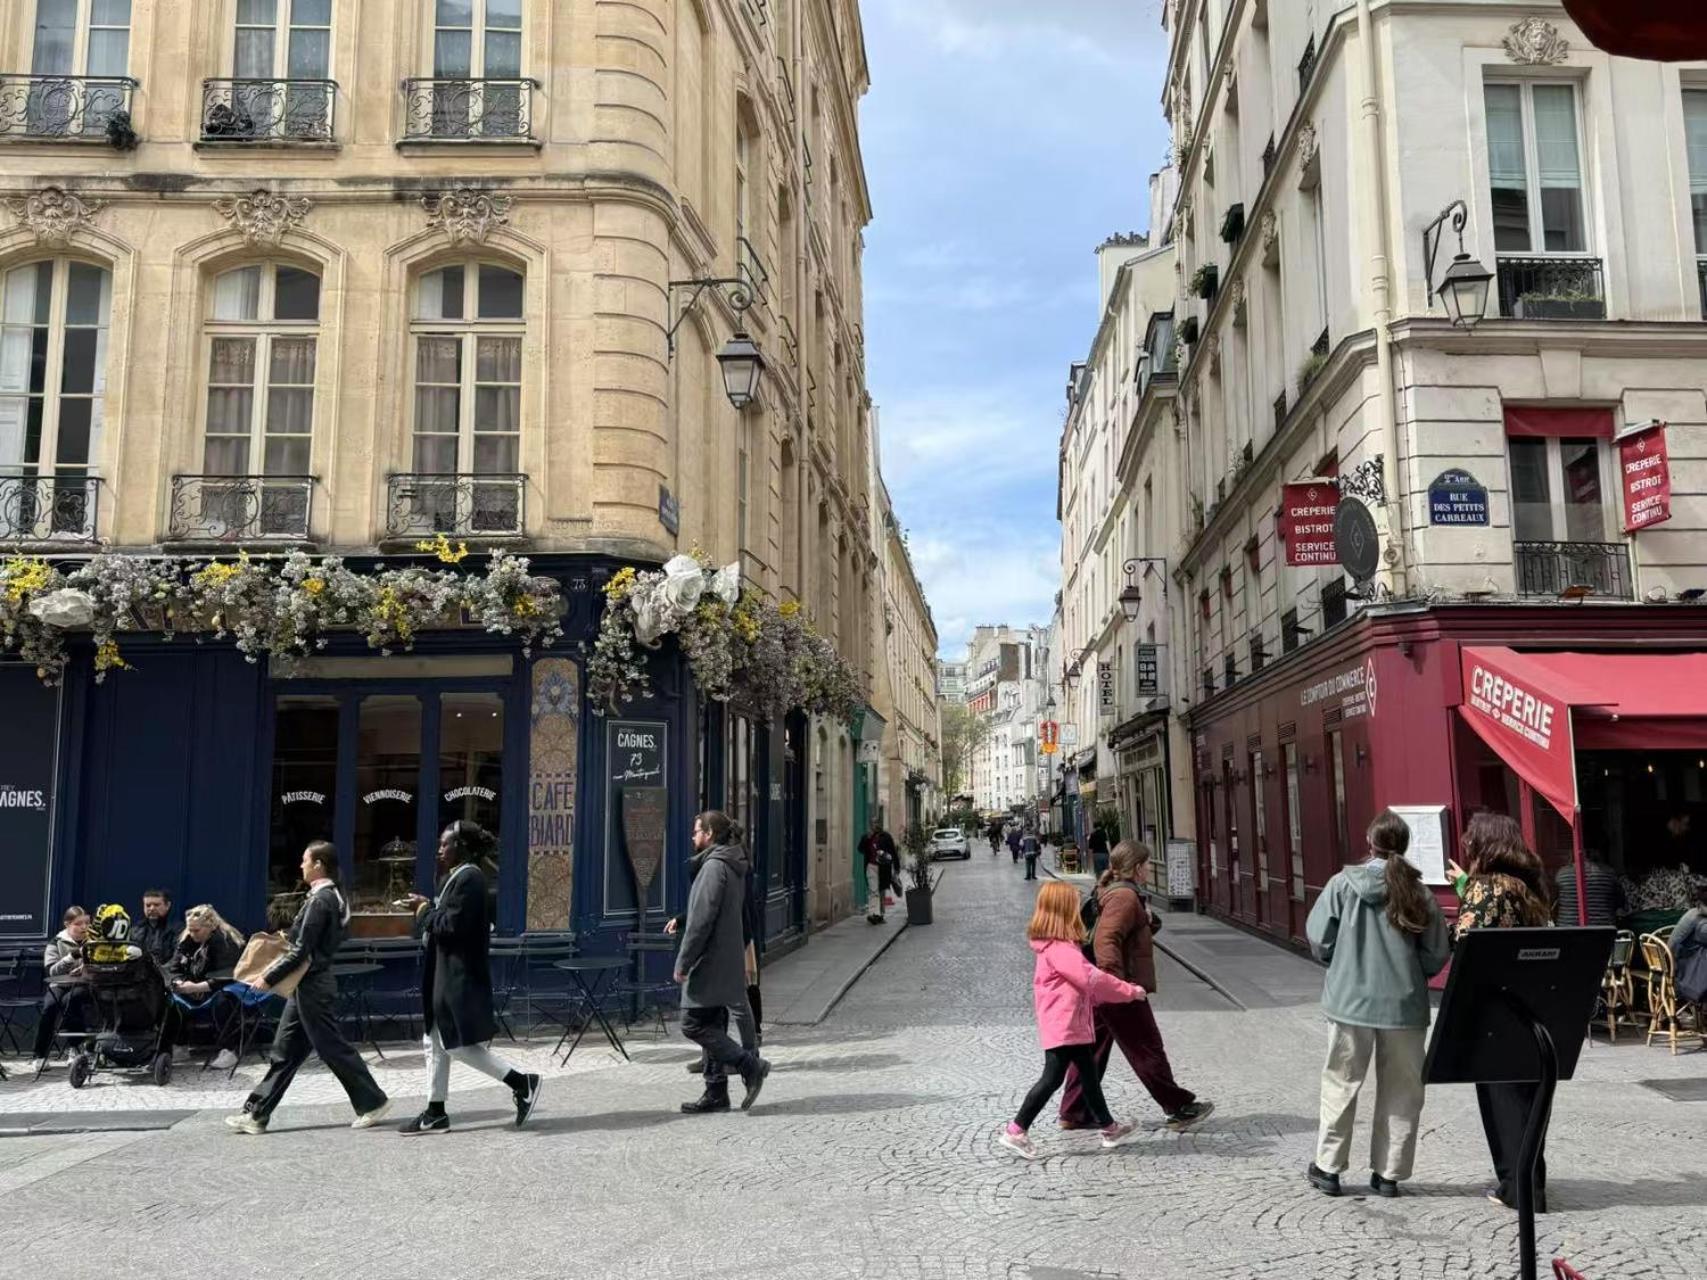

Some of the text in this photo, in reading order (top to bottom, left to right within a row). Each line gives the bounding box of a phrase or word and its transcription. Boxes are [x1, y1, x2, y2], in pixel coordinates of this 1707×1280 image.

[1450, 493, 1468, 501] RUE
[1434, 503, 1485, 511] DES PETITS
[1631, 495, 1662, 513] SERVICE
[1435, 513, 1485, 521] CARREAUX
[1631, 505, 1663, 524] CONTINU
[1294, 524, 1334, 534] BISTROT
[1295, 542, 1335, 552] SERVICE
[1294, 552, 1336, 562] CONTINU
[630, 752, 643, 767] 73
[363, 789, 413, 804] VIENNOISERIE
[444, 786, 497, 802] CHOCOLATERIE
